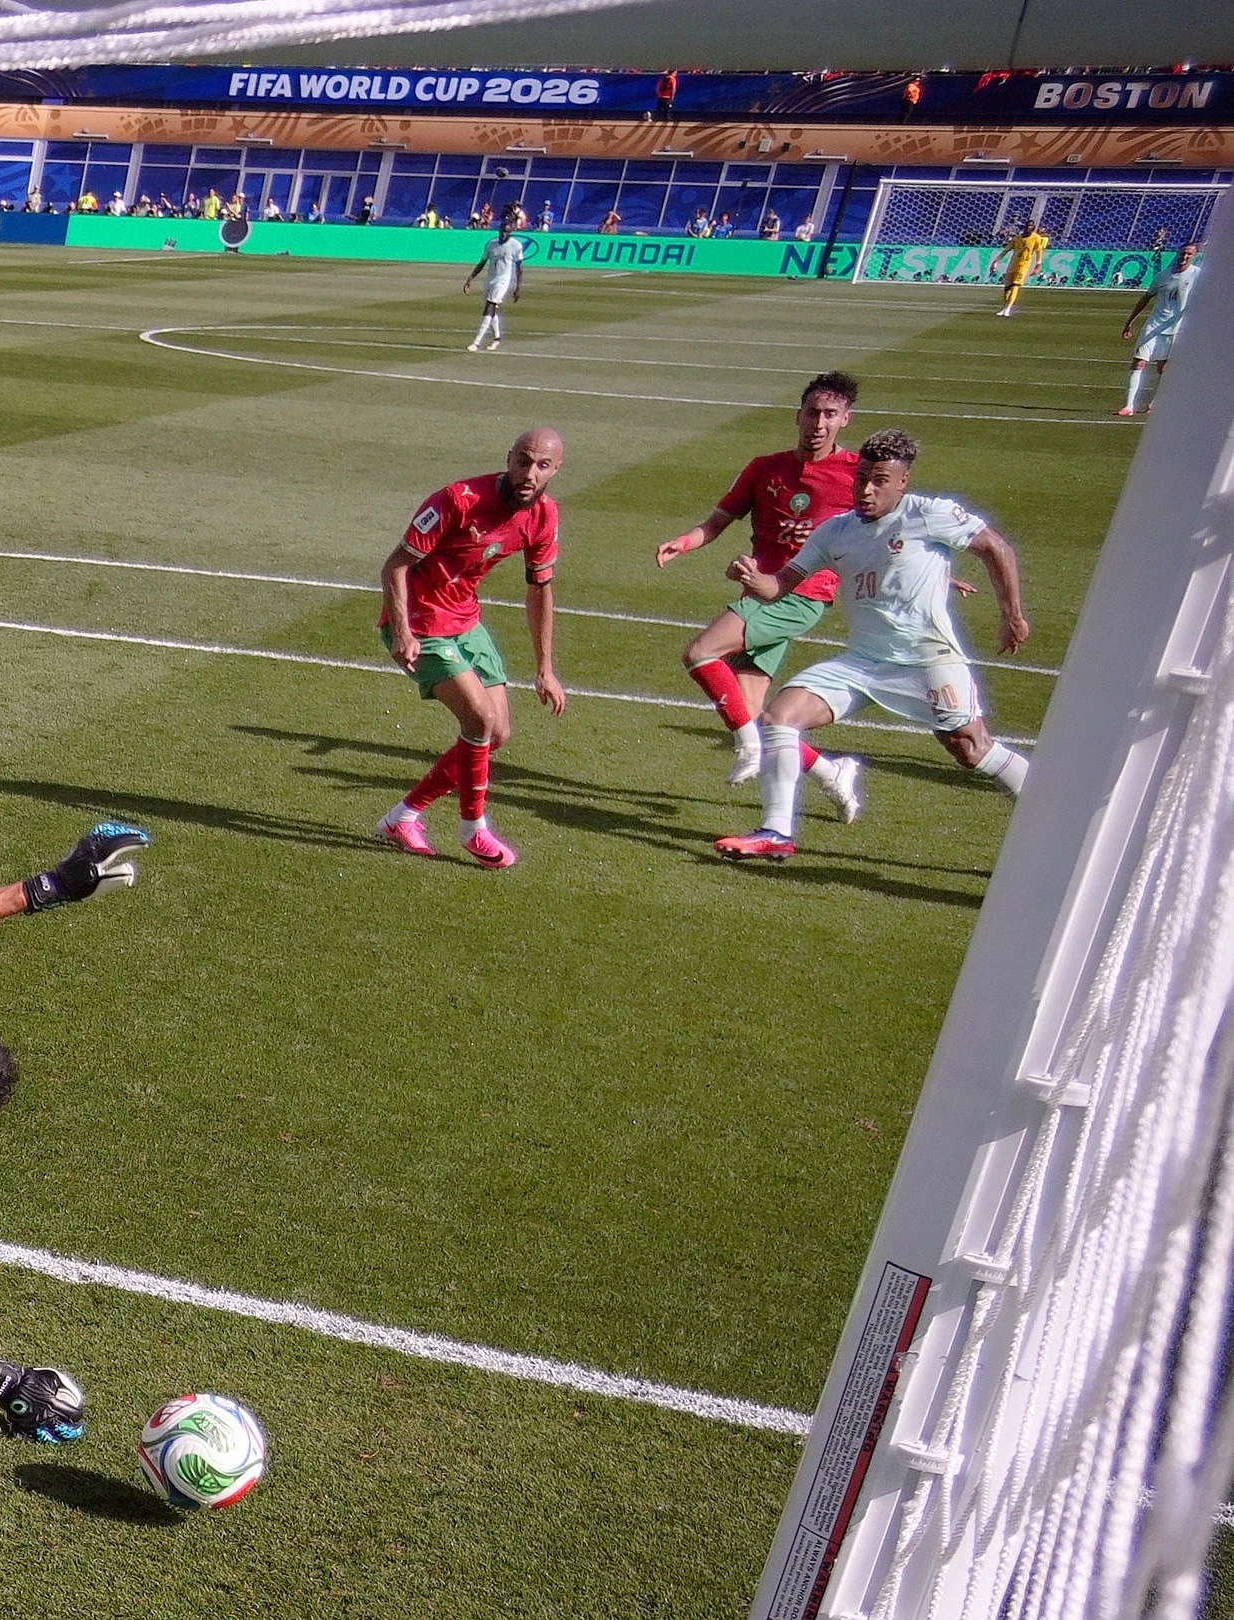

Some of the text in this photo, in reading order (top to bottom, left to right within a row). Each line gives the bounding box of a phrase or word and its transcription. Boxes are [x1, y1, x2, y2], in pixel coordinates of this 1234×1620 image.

[229, 73, 598, 105] FIFA WORLD CUP 2026
[1033, 81, 1214, 110] BOSTON
[547, 239, 697, 267] HYUNDAI
[855, 571, 877, 600] 20
[807, 1539, 822, 1572] ALWAYS
[795, 1573, 810, 1605] ANCHOR
[803, 1559, 832, 1620] WARNIN
